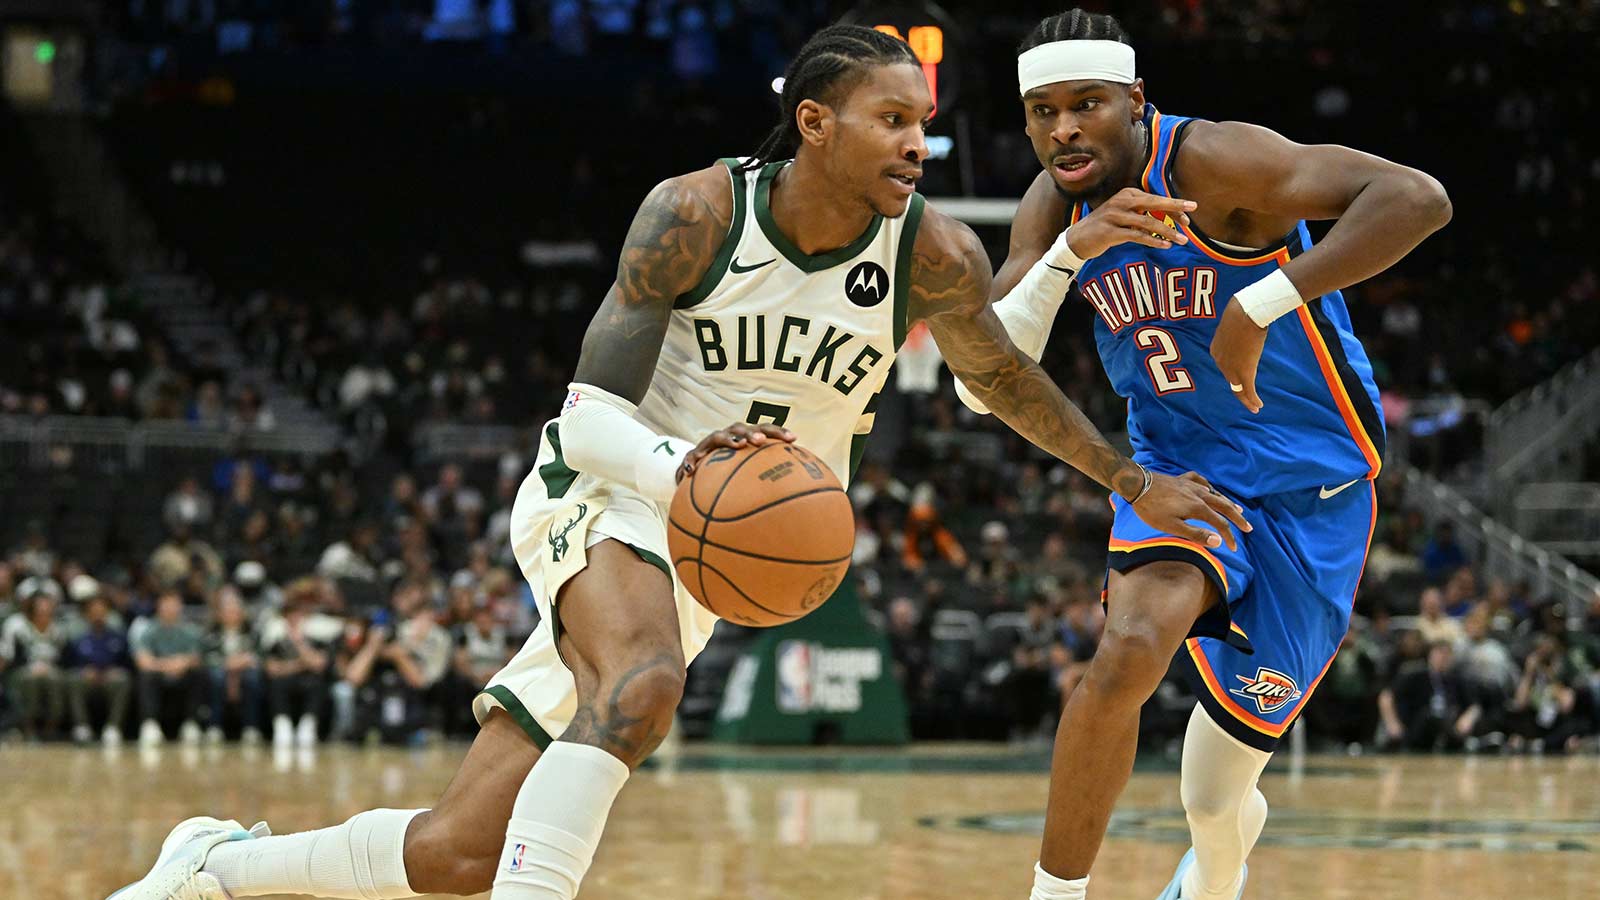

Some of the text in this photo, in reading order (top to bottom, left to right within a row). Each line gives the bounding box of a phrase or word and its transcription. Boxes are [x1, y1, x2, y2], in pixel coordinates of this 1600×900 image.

[1082, 261, 1217, 335] HUNDER
[693, 314, 884, 396] BUCKS
[1133, 326, 1196, 396] 2
[1244, 680, 1291, 698] OKC
